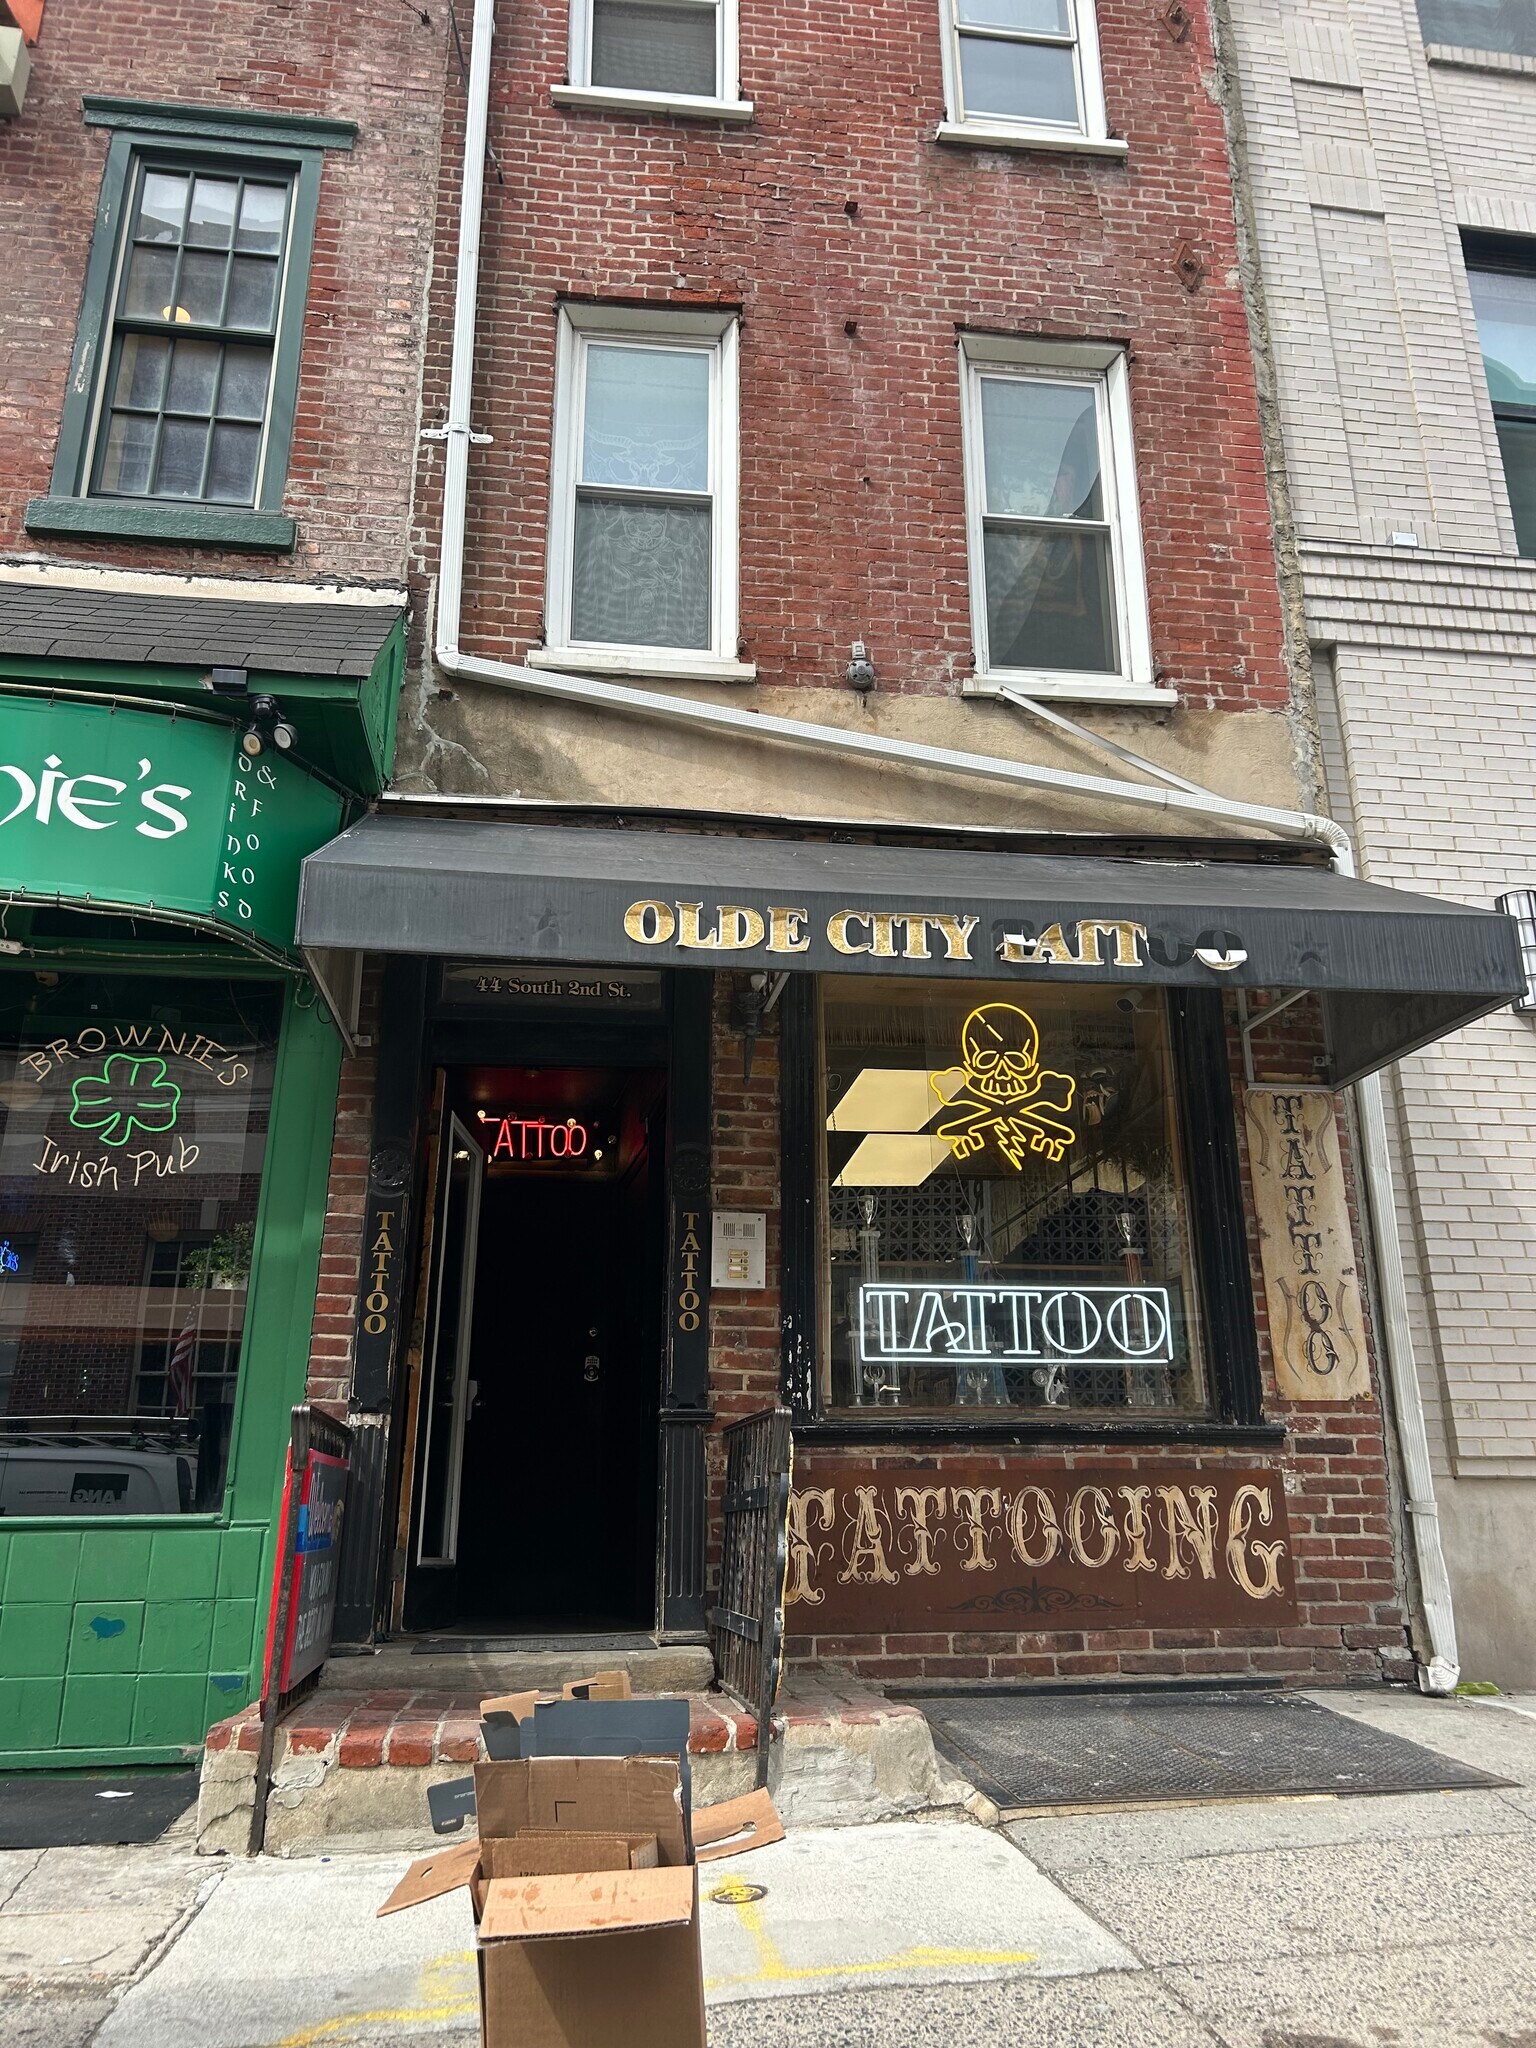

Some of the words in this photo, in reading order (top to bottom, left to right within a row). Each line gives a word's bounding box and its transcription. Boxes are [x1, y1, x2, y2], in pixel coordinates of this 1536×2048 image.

[623, 900, 811, 953] OLDE
[827, 908, 980, 960] CITY
[476, 976, 502, 993] 44
[508, 977, 562, 996] South
[568, 981, 601, 997] 2nd
[607, 982, 632, 998] St.
[20, 1024, 249, 1087] BROWNIE'S
[33, 1135, 119, 1191] Irish
[127, 1137, 199, 1186] Pub
[1272, 1094, 1339, 1375] TATTOO
[364, 1210, 395, 1334] TATTOO
[679, 1211, 701, 1332] TATTOO
[866, 1291, 1166, 1355] TATTOO
[785, 1484, 1285, 1605] TATTOOING
